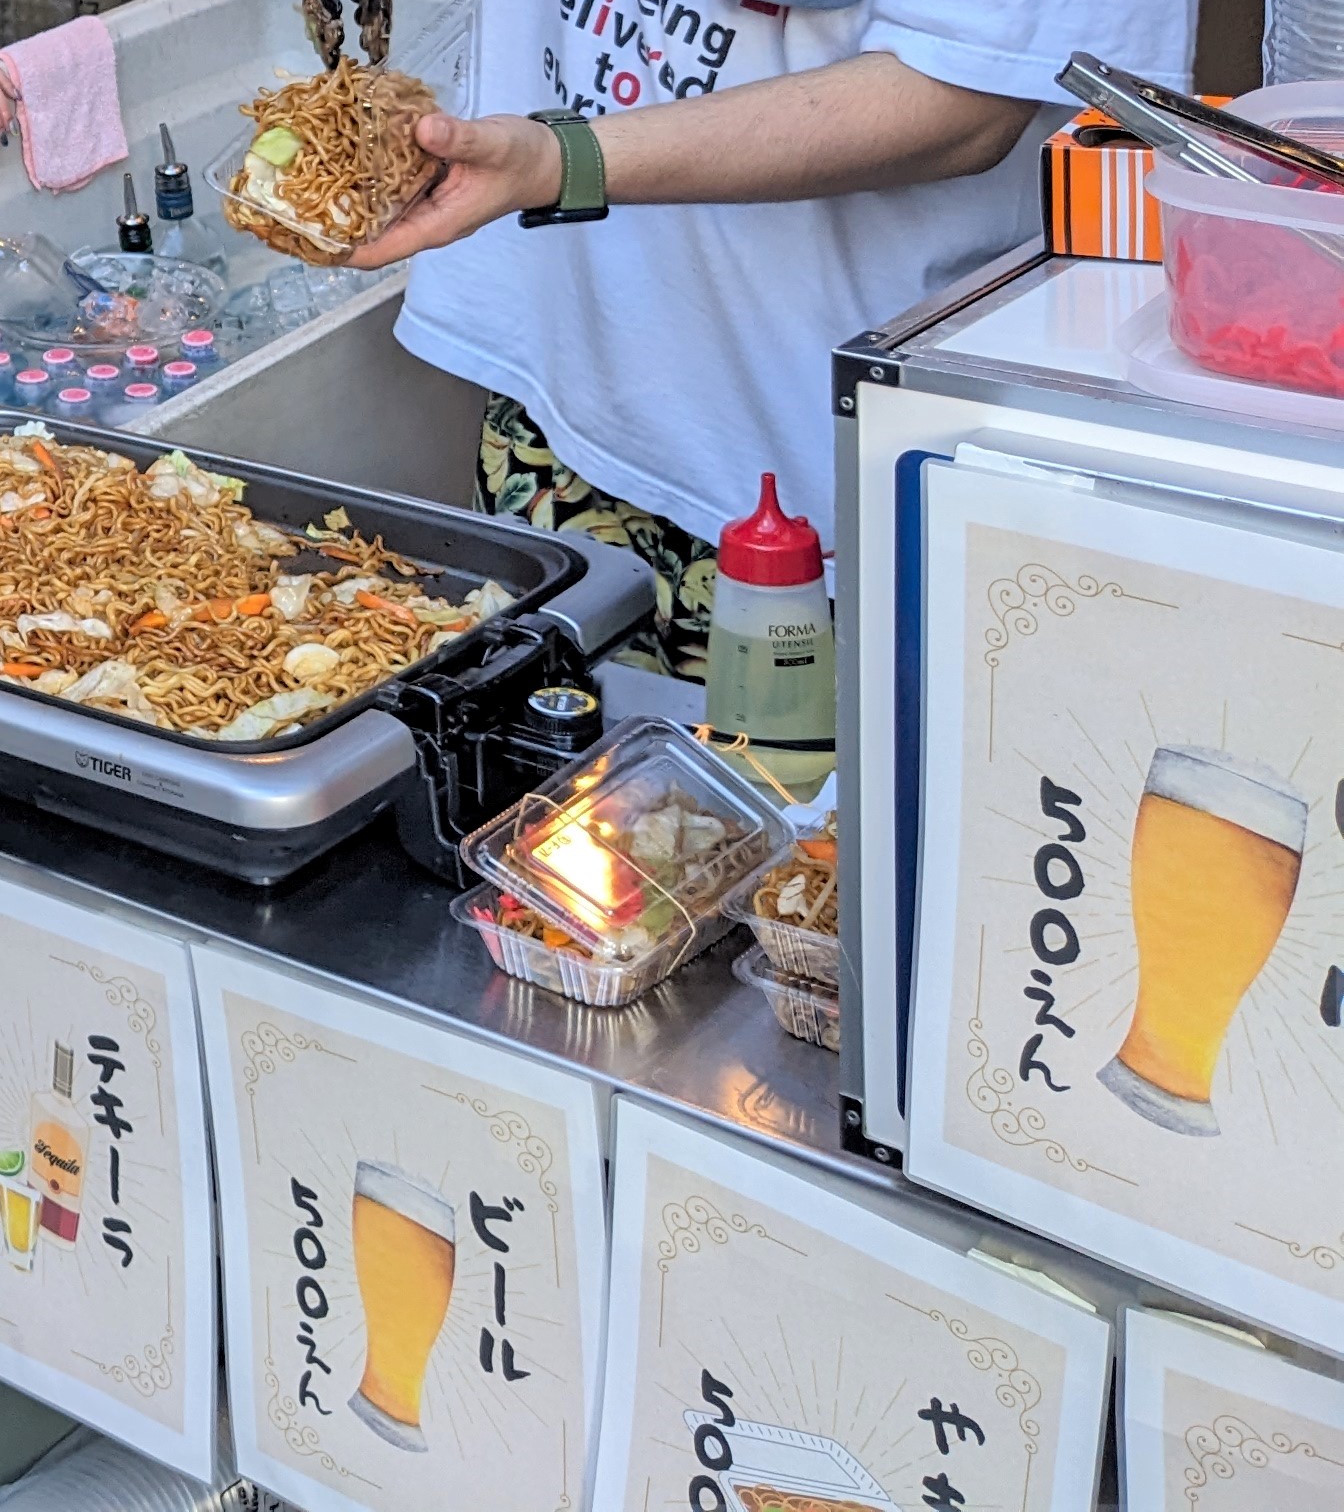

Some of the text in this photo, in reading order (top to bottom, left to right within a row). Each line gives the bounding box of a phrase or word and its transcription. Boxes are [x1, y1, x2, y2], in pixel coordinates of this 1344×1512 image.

[593, 51, 641, 106] to
[768, 623, 816, 638] FORMA
[89, 756, 132, 781] TIGER
[86, 1034, 135, 1268] テキーラ
[470, 1191, 531, 1381] ビール
